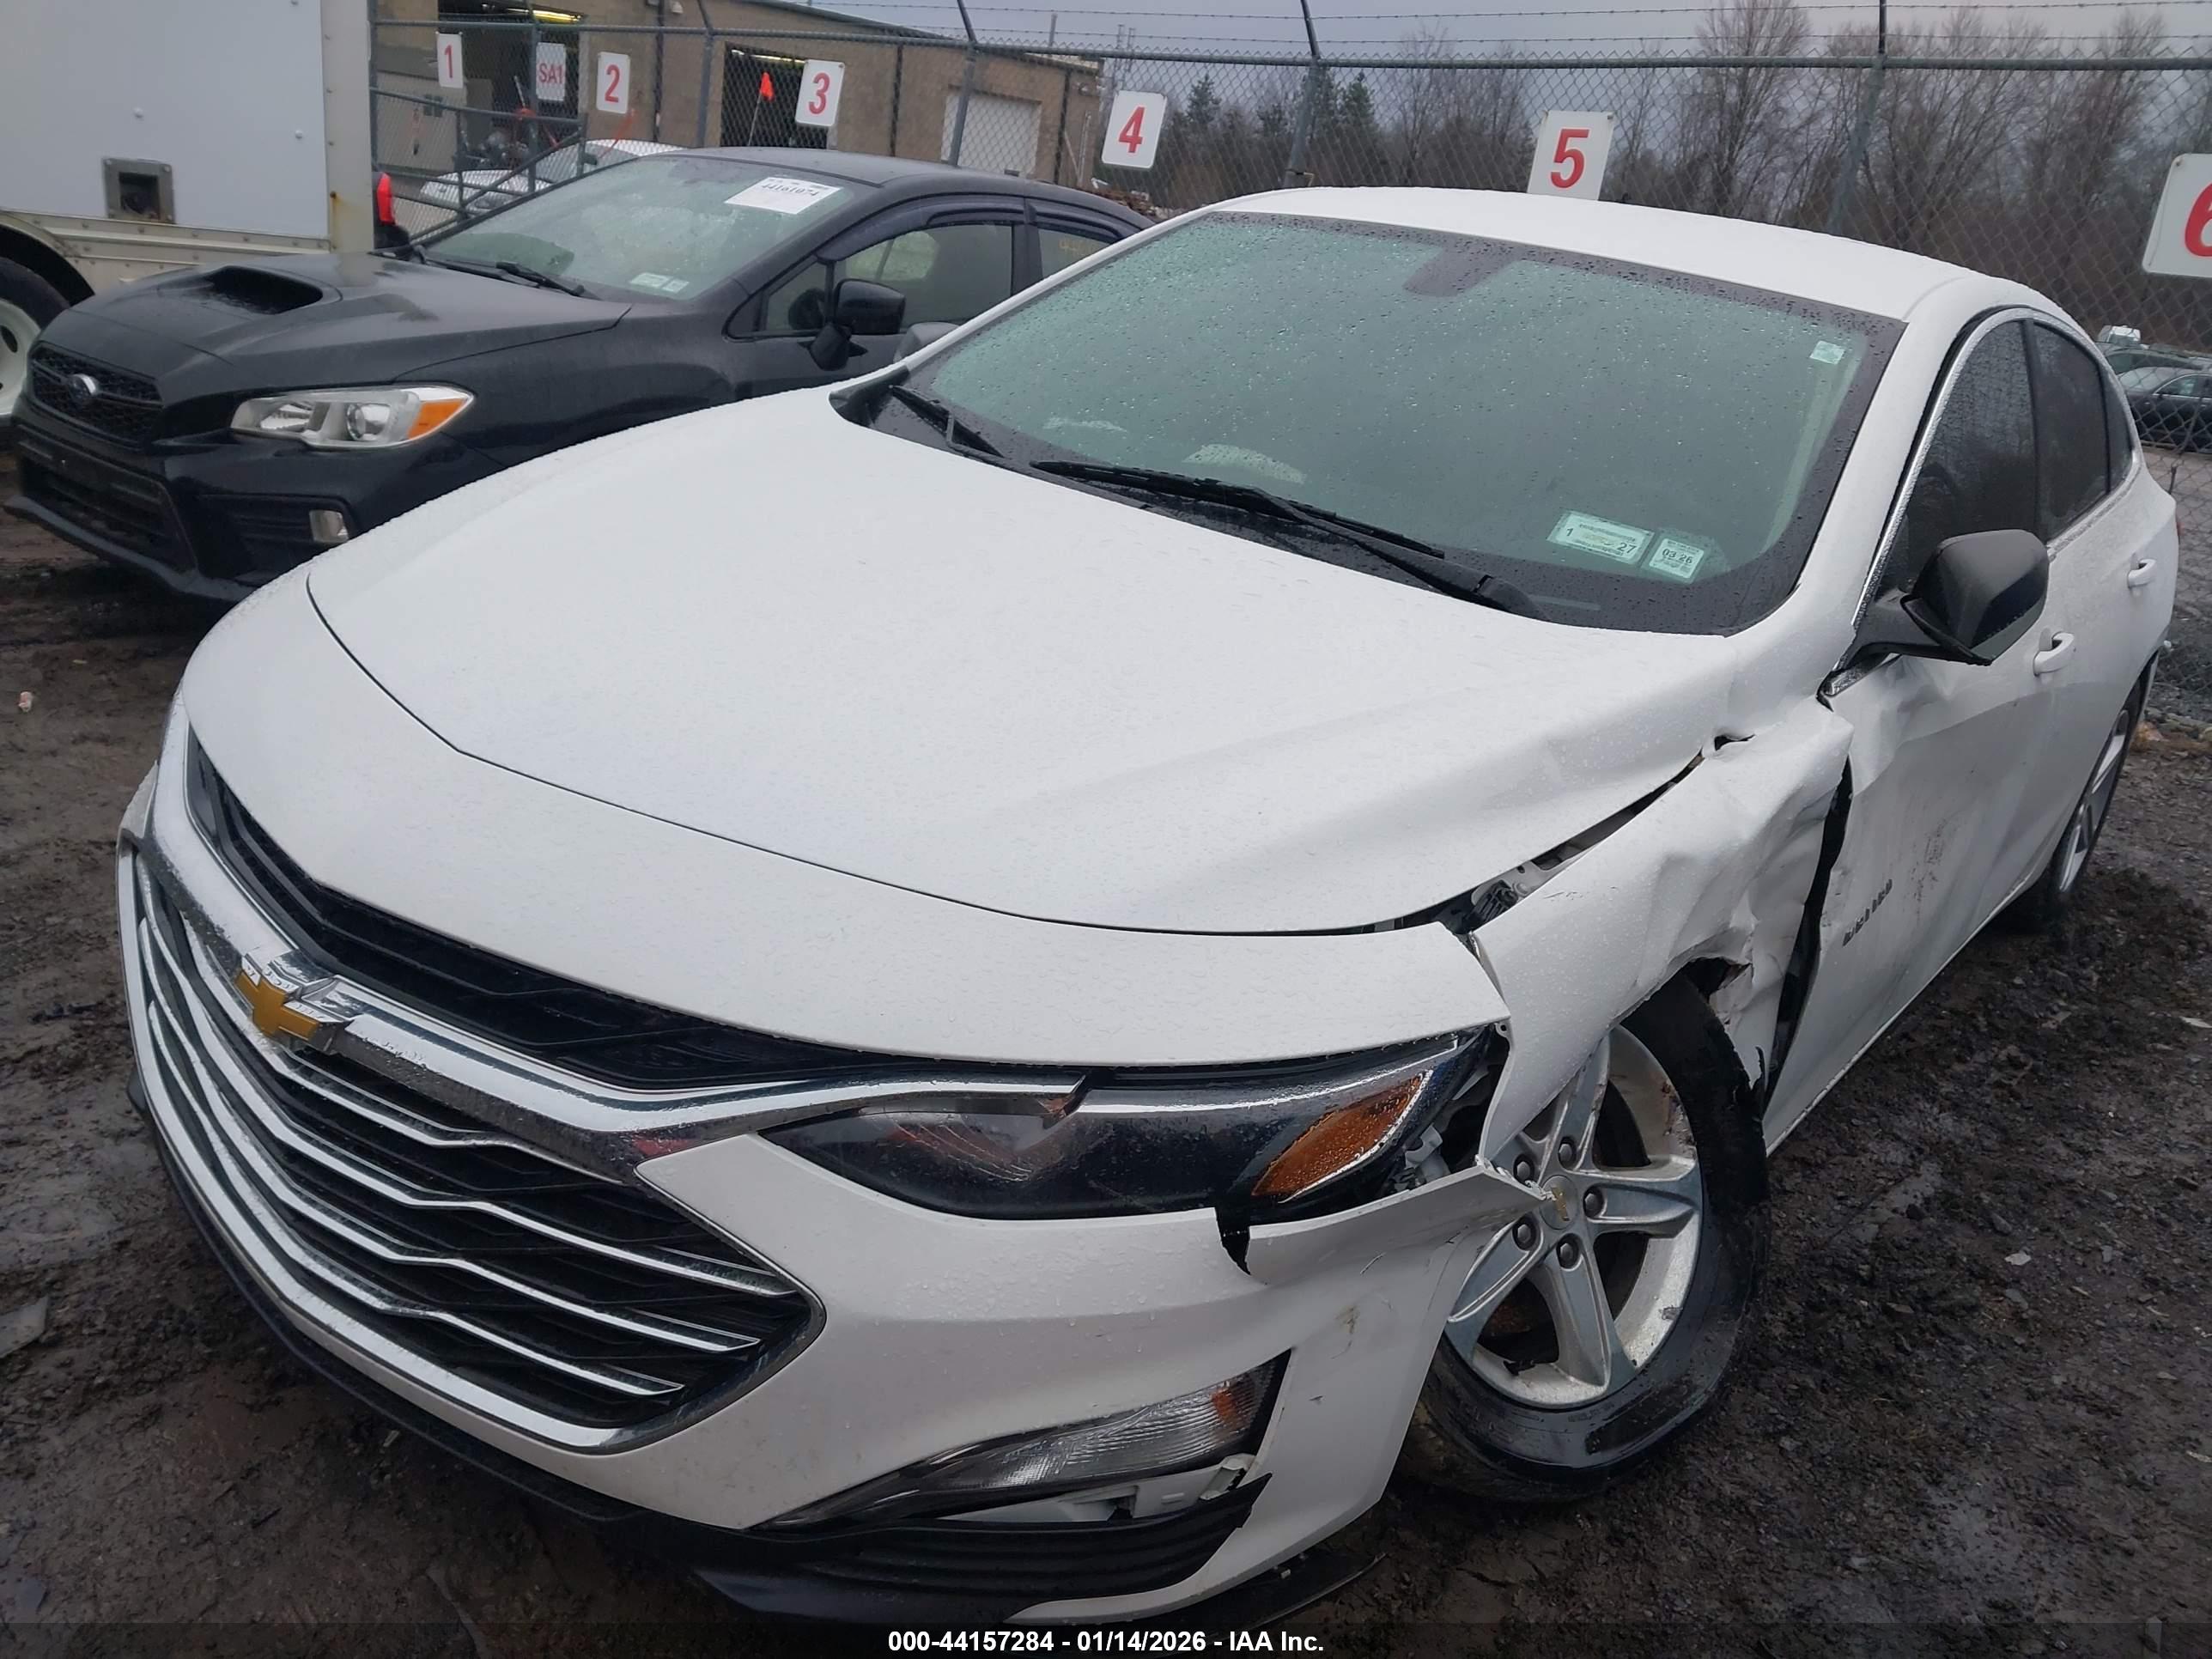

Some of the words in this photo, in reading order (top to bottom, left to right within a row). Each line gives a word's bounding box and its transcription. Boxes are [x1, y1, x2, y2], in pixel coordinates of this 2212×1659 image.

[444, 44, 454, 80] 1
[538, 63, 565, 85] SA1
[605, 64, 622, 104] 2
[809, 73, 830, 115] 3
[1117, 106, 1146, 153] 4
[1550, 127, 1590, 190] 5
[1566, 527, 1574, 537] 1
[1617, 542, 1637, 554] 27
[1662, 548, 1676, 558] 03
[1678, 553, 1693, 564] 26
